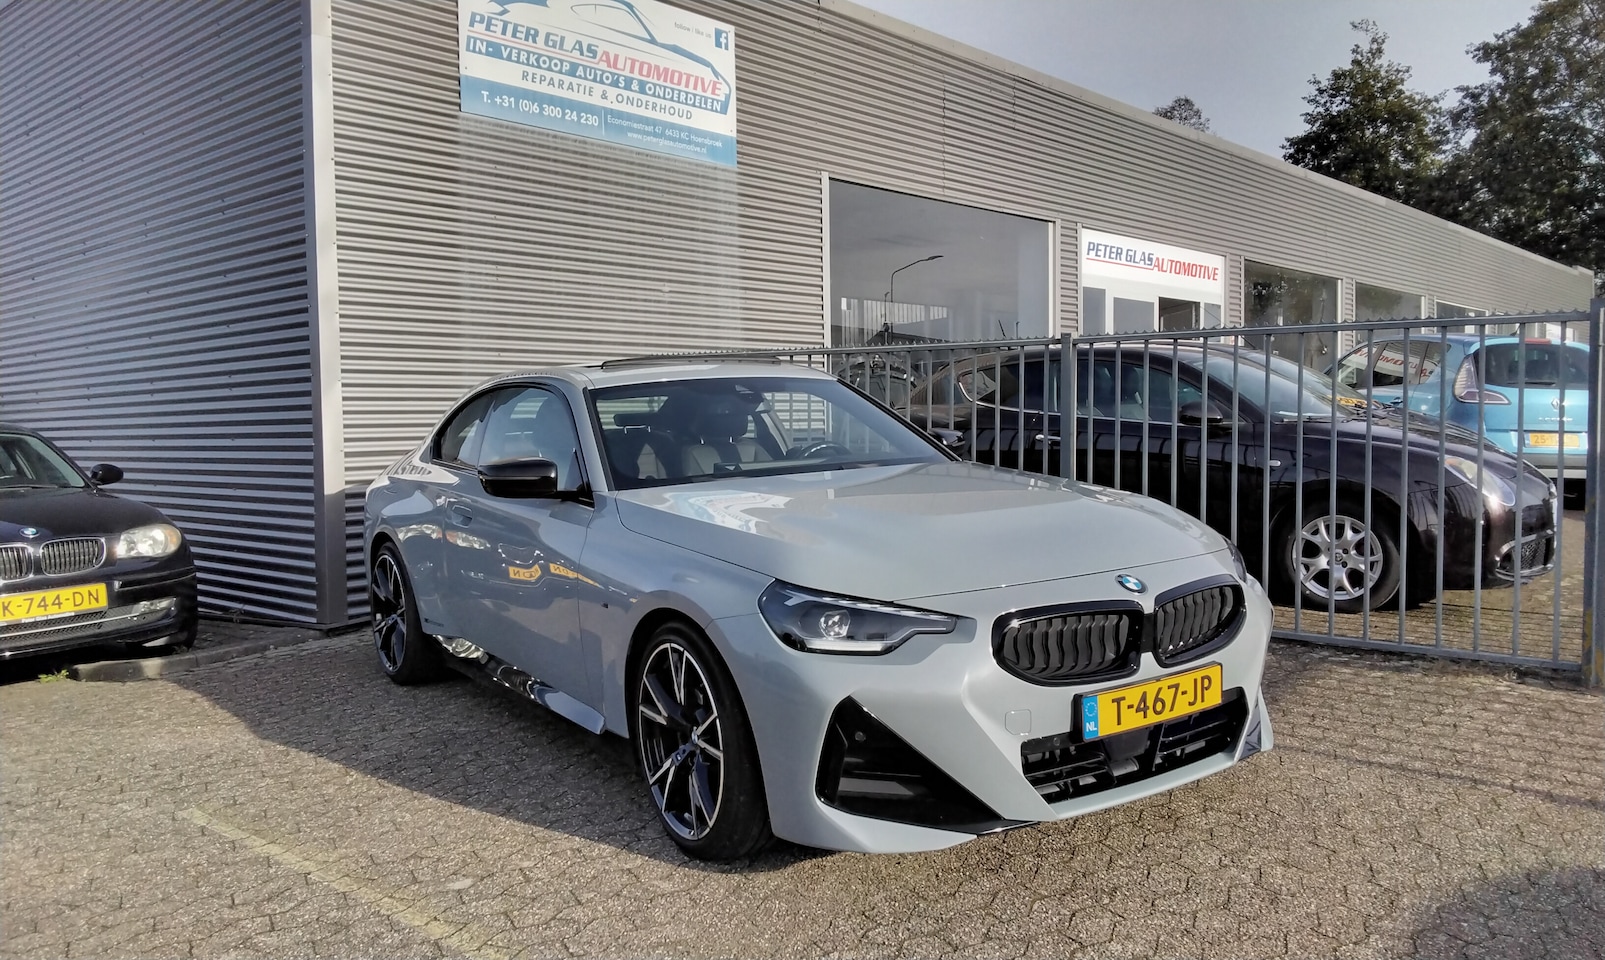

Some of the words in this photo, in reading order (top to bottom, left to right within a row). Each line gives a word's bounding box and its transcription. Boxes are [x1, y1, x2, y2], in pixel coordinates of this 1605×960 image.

[674, 22, 691, 32] follow
[694, 28, 704, 36] like
[468, 11, 540, 44] PETER
[544, 31, 599, 60] GLAS
[598, 50, 723, 96] AUTOMOTIVE
[469, 38, 492, 54] IN-
[500, 46, 570, 72] VERKOOP
[576, 66, 625, 88] AUTO'S
[631, 79, 640, 90] &
[646, 83, 722, 112] ONDERDELEN
[481, 90, 490, 103] T.
[494, 95, 515, 108] +31
[519, 99, 540, 114] (0)6
[542, 104, 562, 118] 300
[565, 110, 578, 122] 24
[580, 113, 599, 126] 230
[522, 70, 594, 96] REPARATIE
[600, 89, 608, 100] &
[616, 92, 693, 120] ONDERHOUD
[608, 115, 654, 133] Economiestraat
[665, 128, 680, 137] 6433
[680, 132, 690, 140] KC
[690, 134, 723, 148] Hoensbroek
[626, 132, 707, 154] www.peterglasautomotive.nl
[1086, 241, 1124, 262] PETER
[1125, 248, 1154, 267] GLAS
[1153, 256, 1219, 281] AUTOMOTIVE
[2, 588, 100, 618] K-744-DN
[1111, 674, 1212, 726] T-467-JP
[1086, 722, 1098, 732] NL
